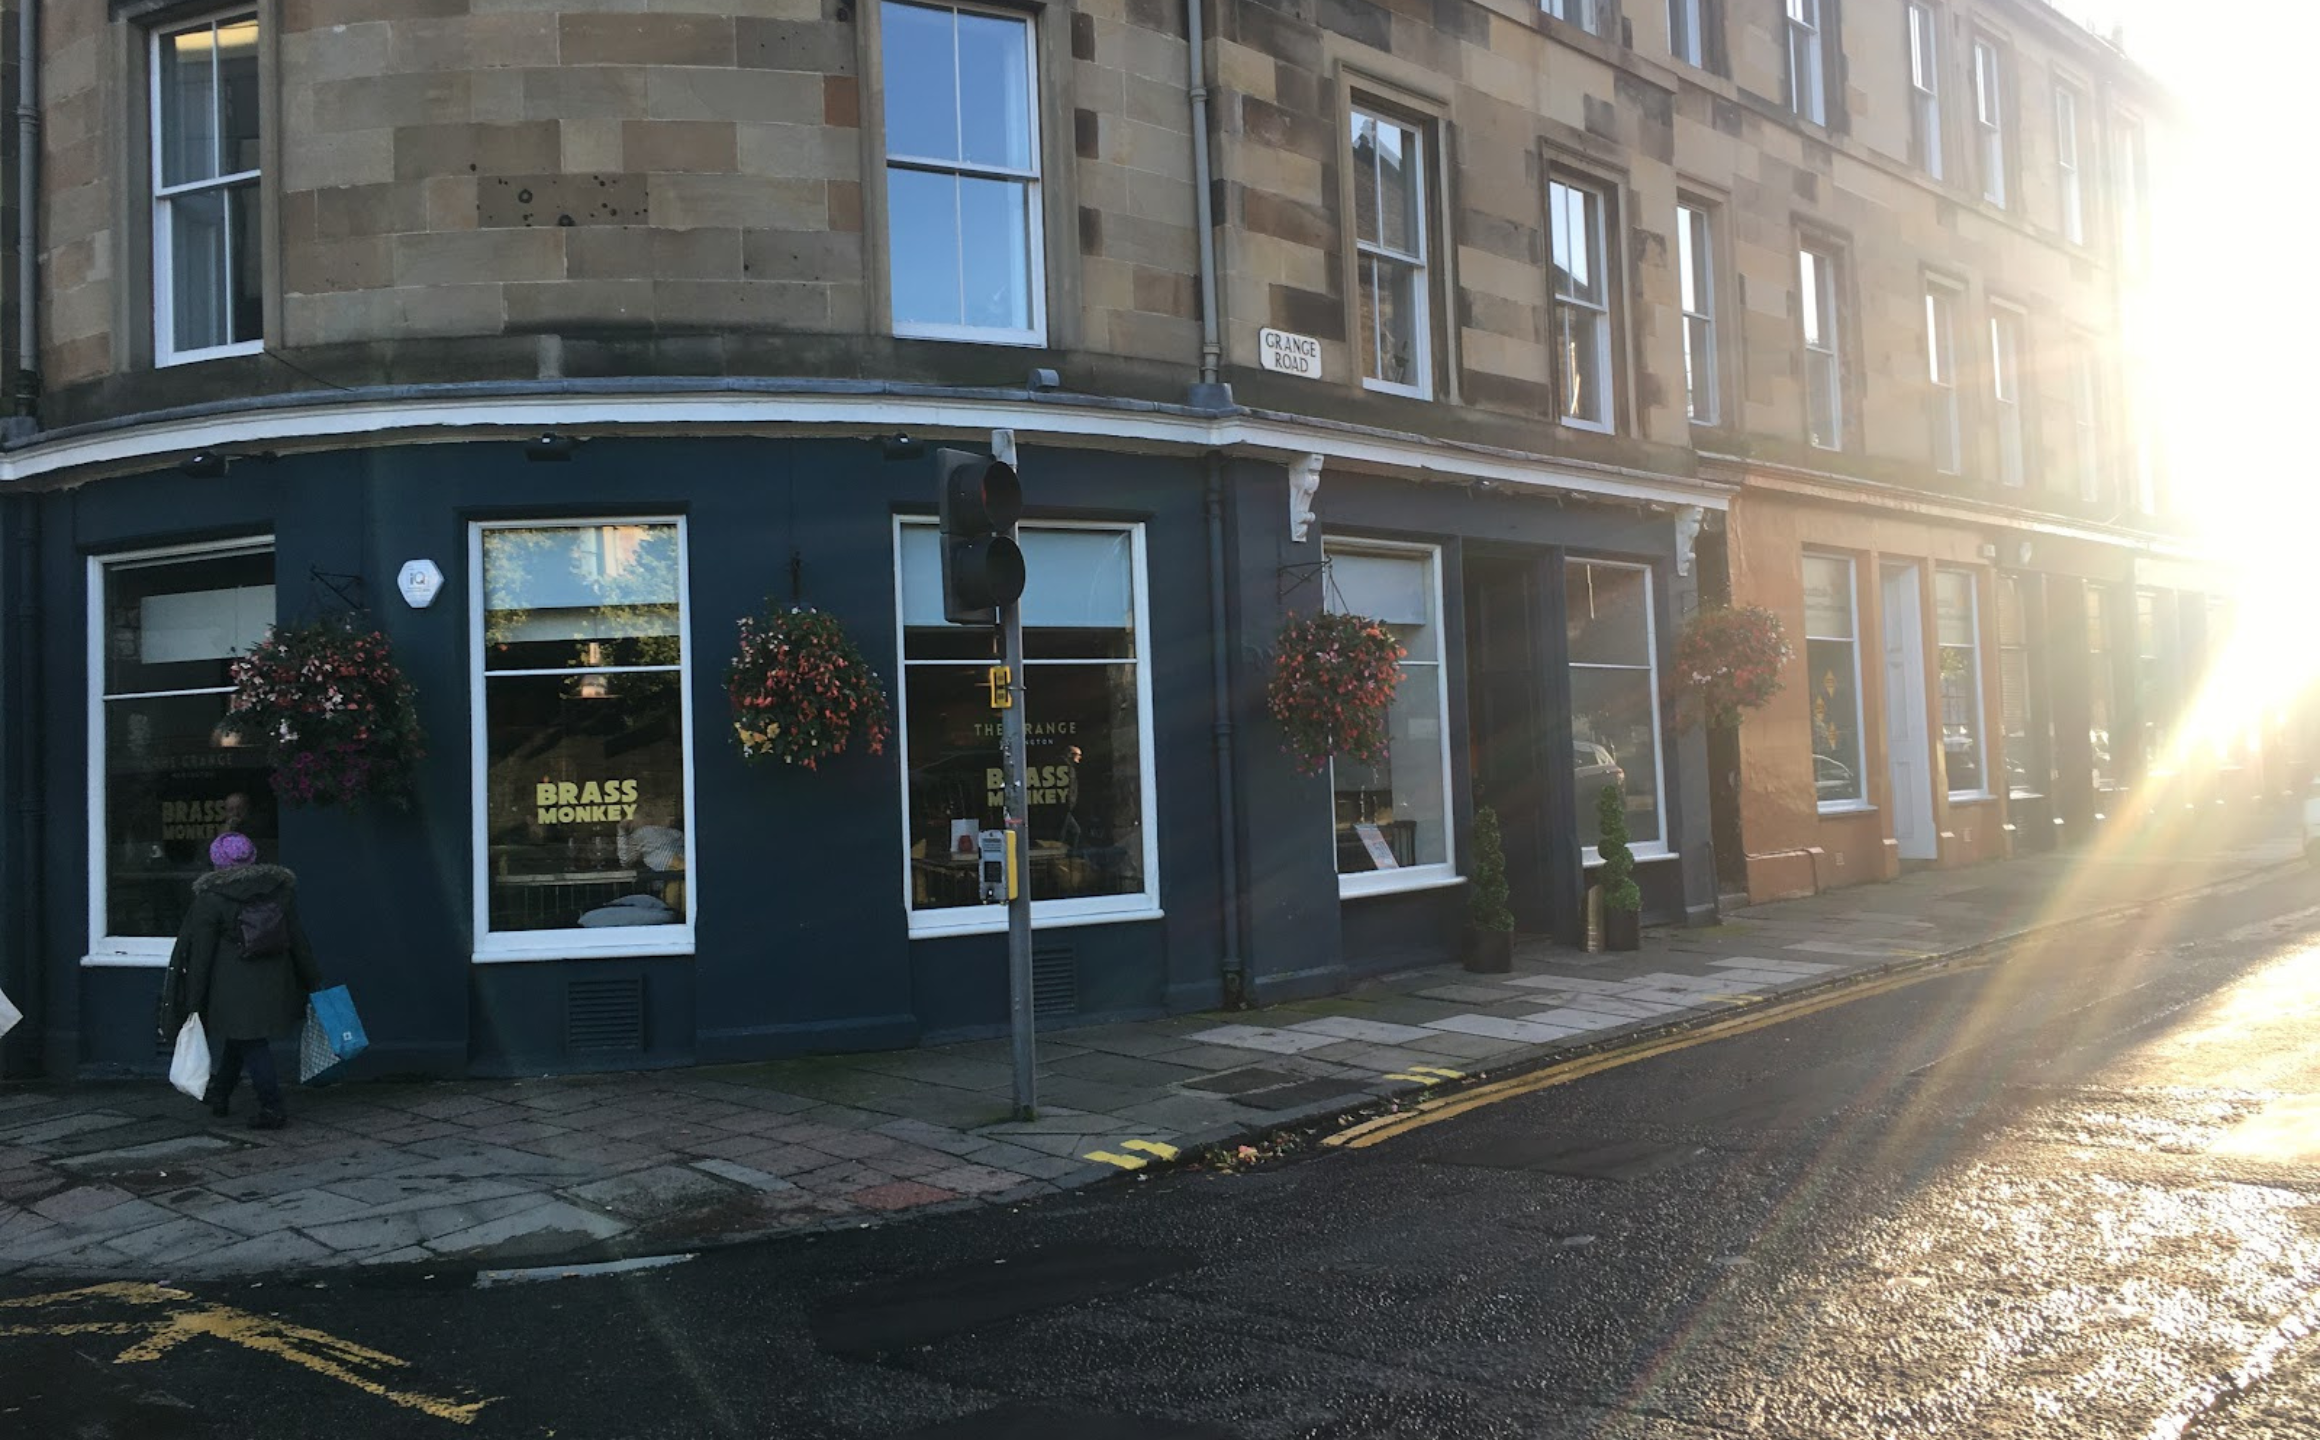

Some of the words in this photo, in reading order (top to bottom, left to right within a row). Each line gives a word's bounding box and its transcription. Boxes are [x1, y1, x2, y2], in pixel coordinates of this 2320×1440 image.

[1265, 332, 1316, 357] GRANGE
[1275, 351, 1309, 373] ROAD
[974, 723, 1003, 736] THE
[1024, 722, 1077, 735] RANGE
[986, 765, 1070, 789] BASS
[536, 779, 638, 806] BRASS
[987, 788, 1070, 807] MKEY
[162, 799, 227, 823] BRASS
[537, 803, 638, 825] MONKEY
